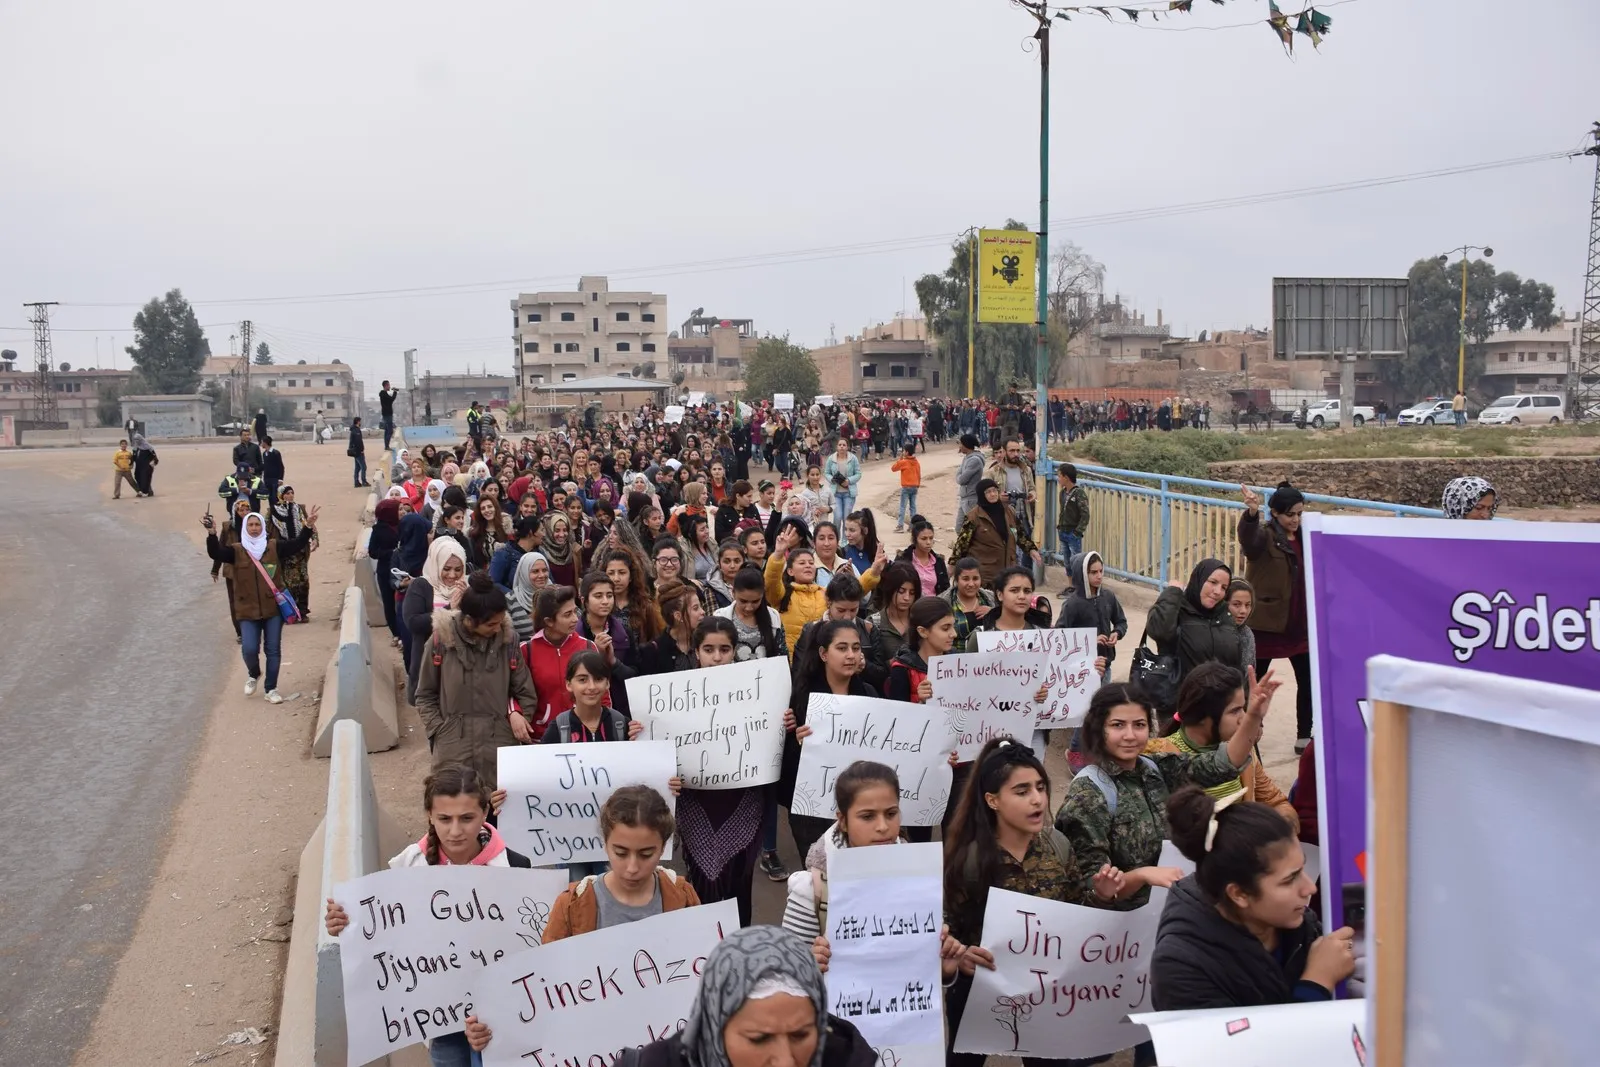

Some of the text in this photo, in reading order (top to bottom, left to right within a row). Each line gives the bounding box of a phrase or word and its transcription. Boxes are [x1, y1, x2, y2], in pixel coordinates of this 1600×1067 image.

[728, 669, 763, 701] rast
[936, 660, 953, 680] Em
[957, 657, 968, 678] bi
[744, 711, 769, 752] jinê
[880, 717, 931, 753] Azad
[555, 753, 612, 790] Jin
[359, 887, 505, 941] Jin Gula
[1008, 909, 1140, 965] Jin Gula
[372, 940, 462, 993] Jiyanê
[511, 920, 724, 1024] Jinek Aza
[1028, 967, 1124, 1017] Jiyanê
